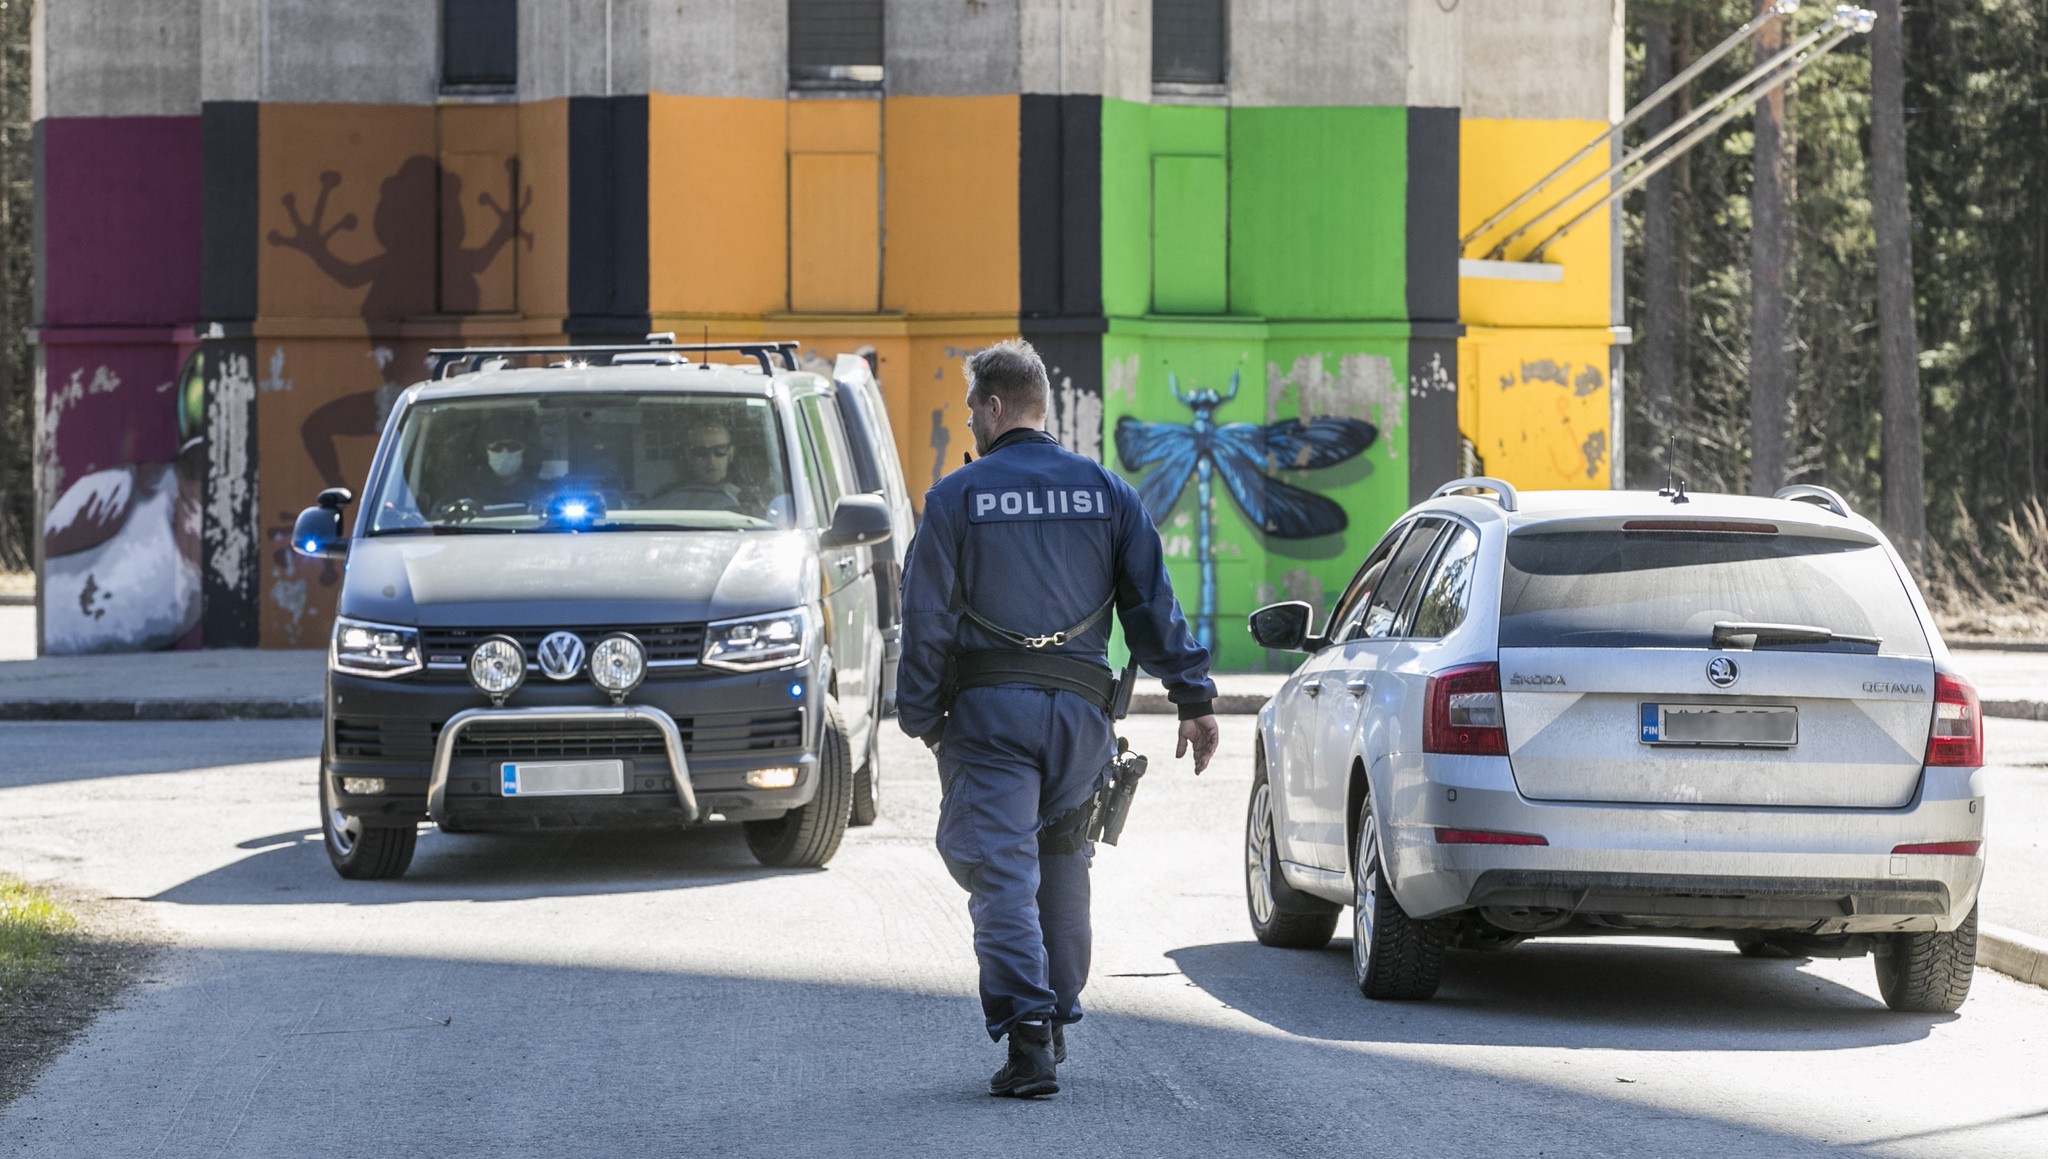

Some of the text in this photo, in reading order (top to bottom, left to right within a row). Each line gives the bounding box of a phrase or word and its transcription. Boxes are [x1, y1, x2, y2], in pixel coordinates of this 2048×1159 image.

[976, 490, 1105, 516] POLIISI
[1862, 681, 1926, 695] OCTAVIA
[1643, 725, 1658, 735] FIN
